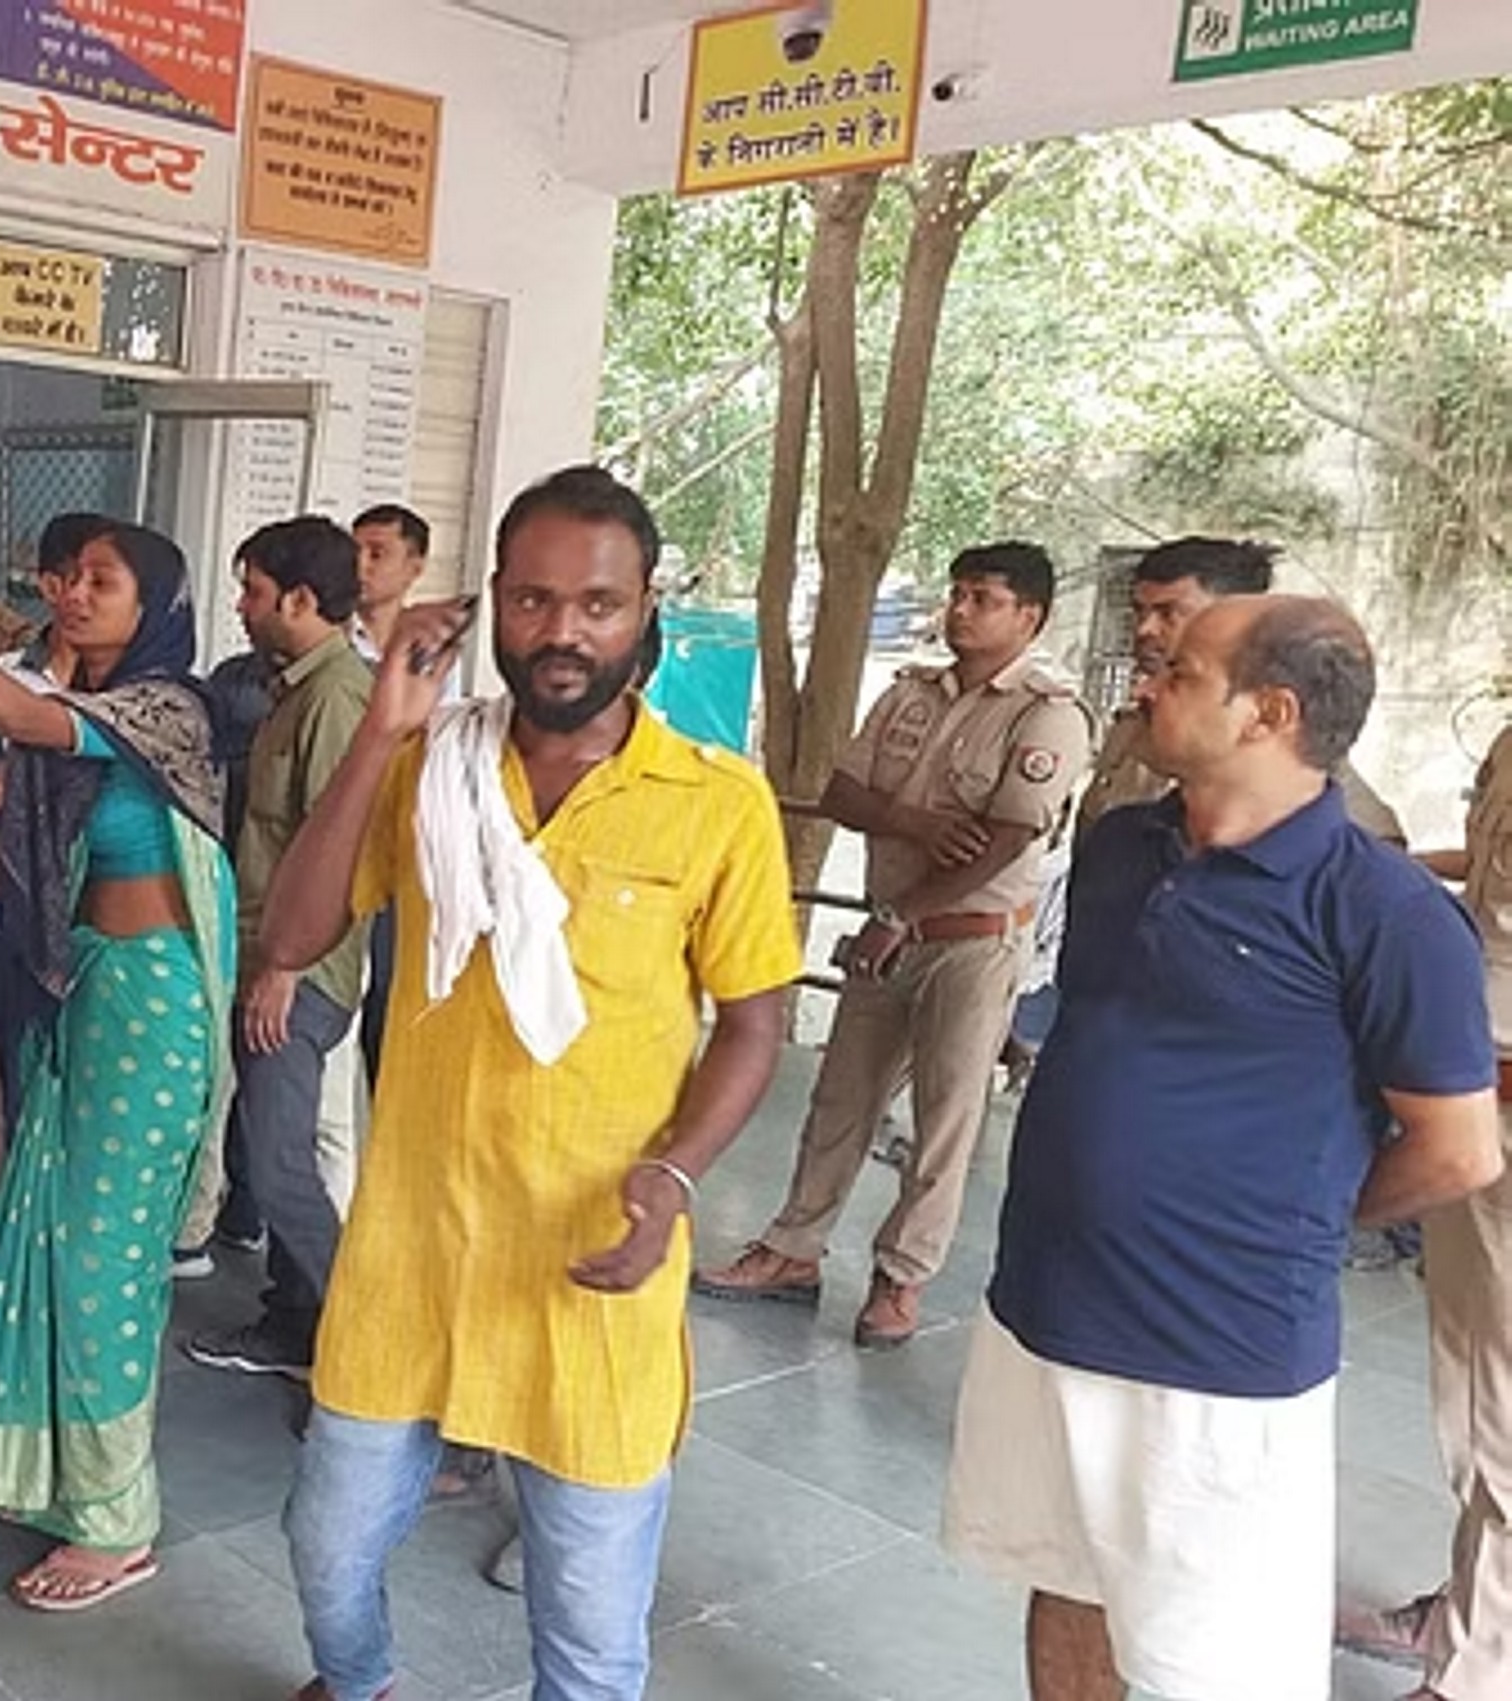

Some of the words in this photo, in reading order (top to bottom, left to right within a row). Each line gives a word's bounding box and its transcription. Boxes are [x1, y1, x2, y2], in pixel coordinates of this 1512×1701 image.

[1245, 20, 1340, 51] WAITING
[1345, 10, 1408, 36] AREA
[702, 95, 748, 123] आप
[697, 140, 716, 169] के
[728, 122, 825, 165] निगरानी
[836, 116, 860, 147] में
[38, 259, 65, 285] CC
[69, 262, 93, 286] TV
